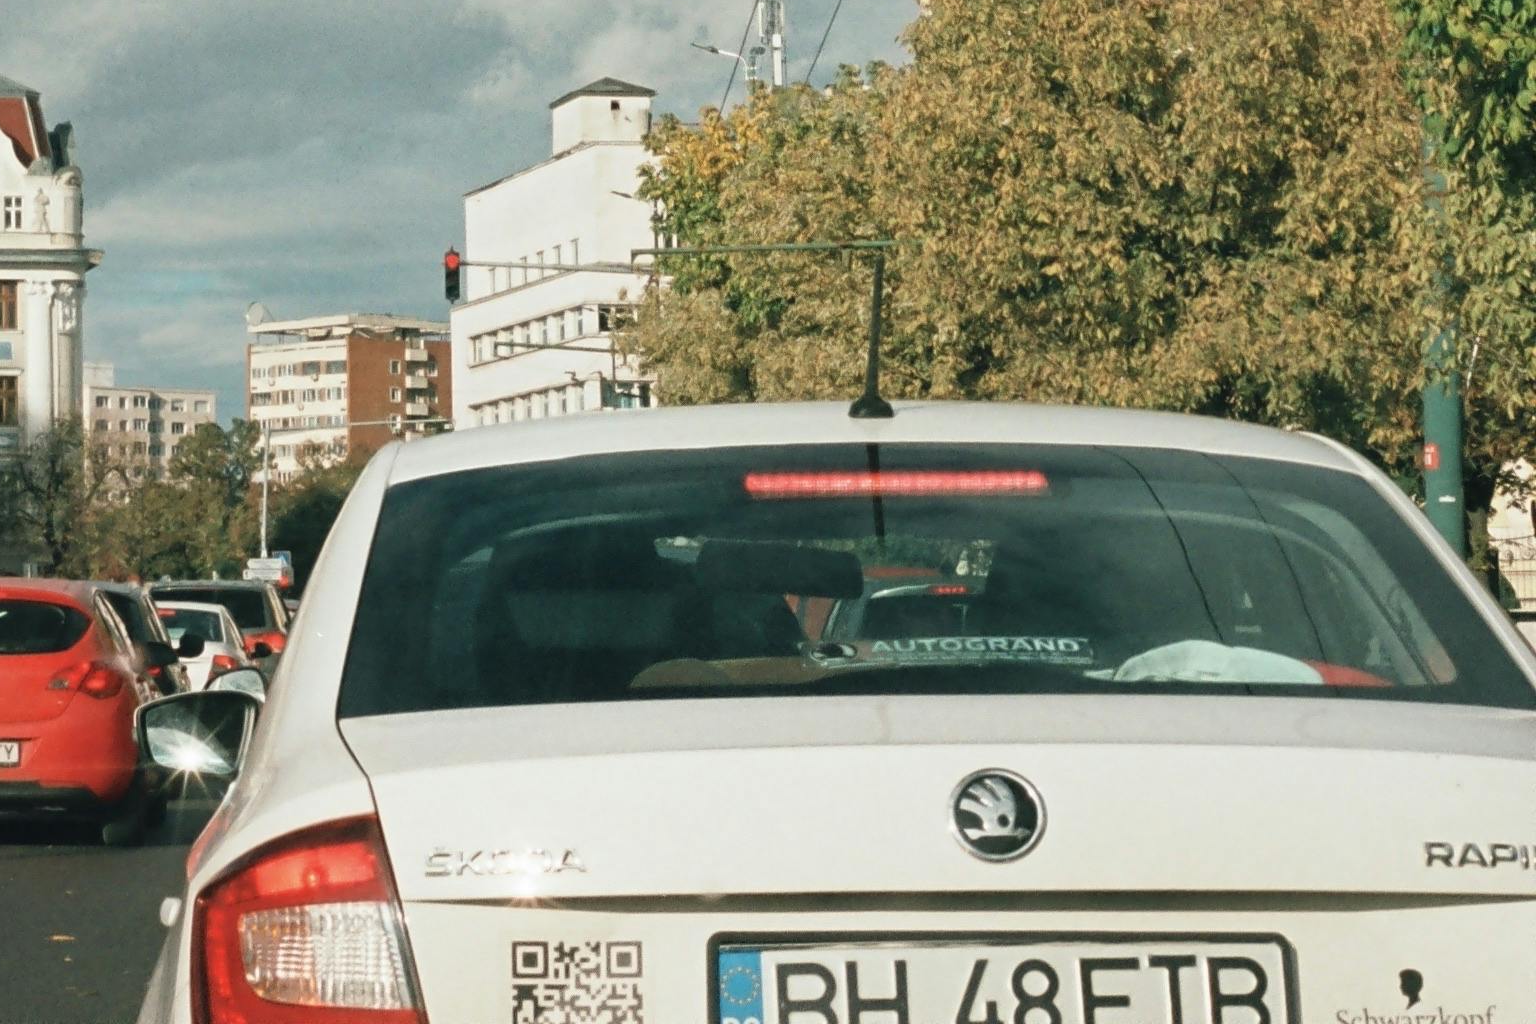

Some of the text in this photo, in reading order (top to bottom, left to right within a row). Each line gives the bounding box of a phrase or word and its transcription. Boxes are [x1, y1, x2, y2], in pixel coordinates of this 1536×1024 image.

[871, 638, 1081, 653] AUTOGRAND
[1424, 842, 1536, 870] RAPI
[775, 960, 910, 1024] BH
